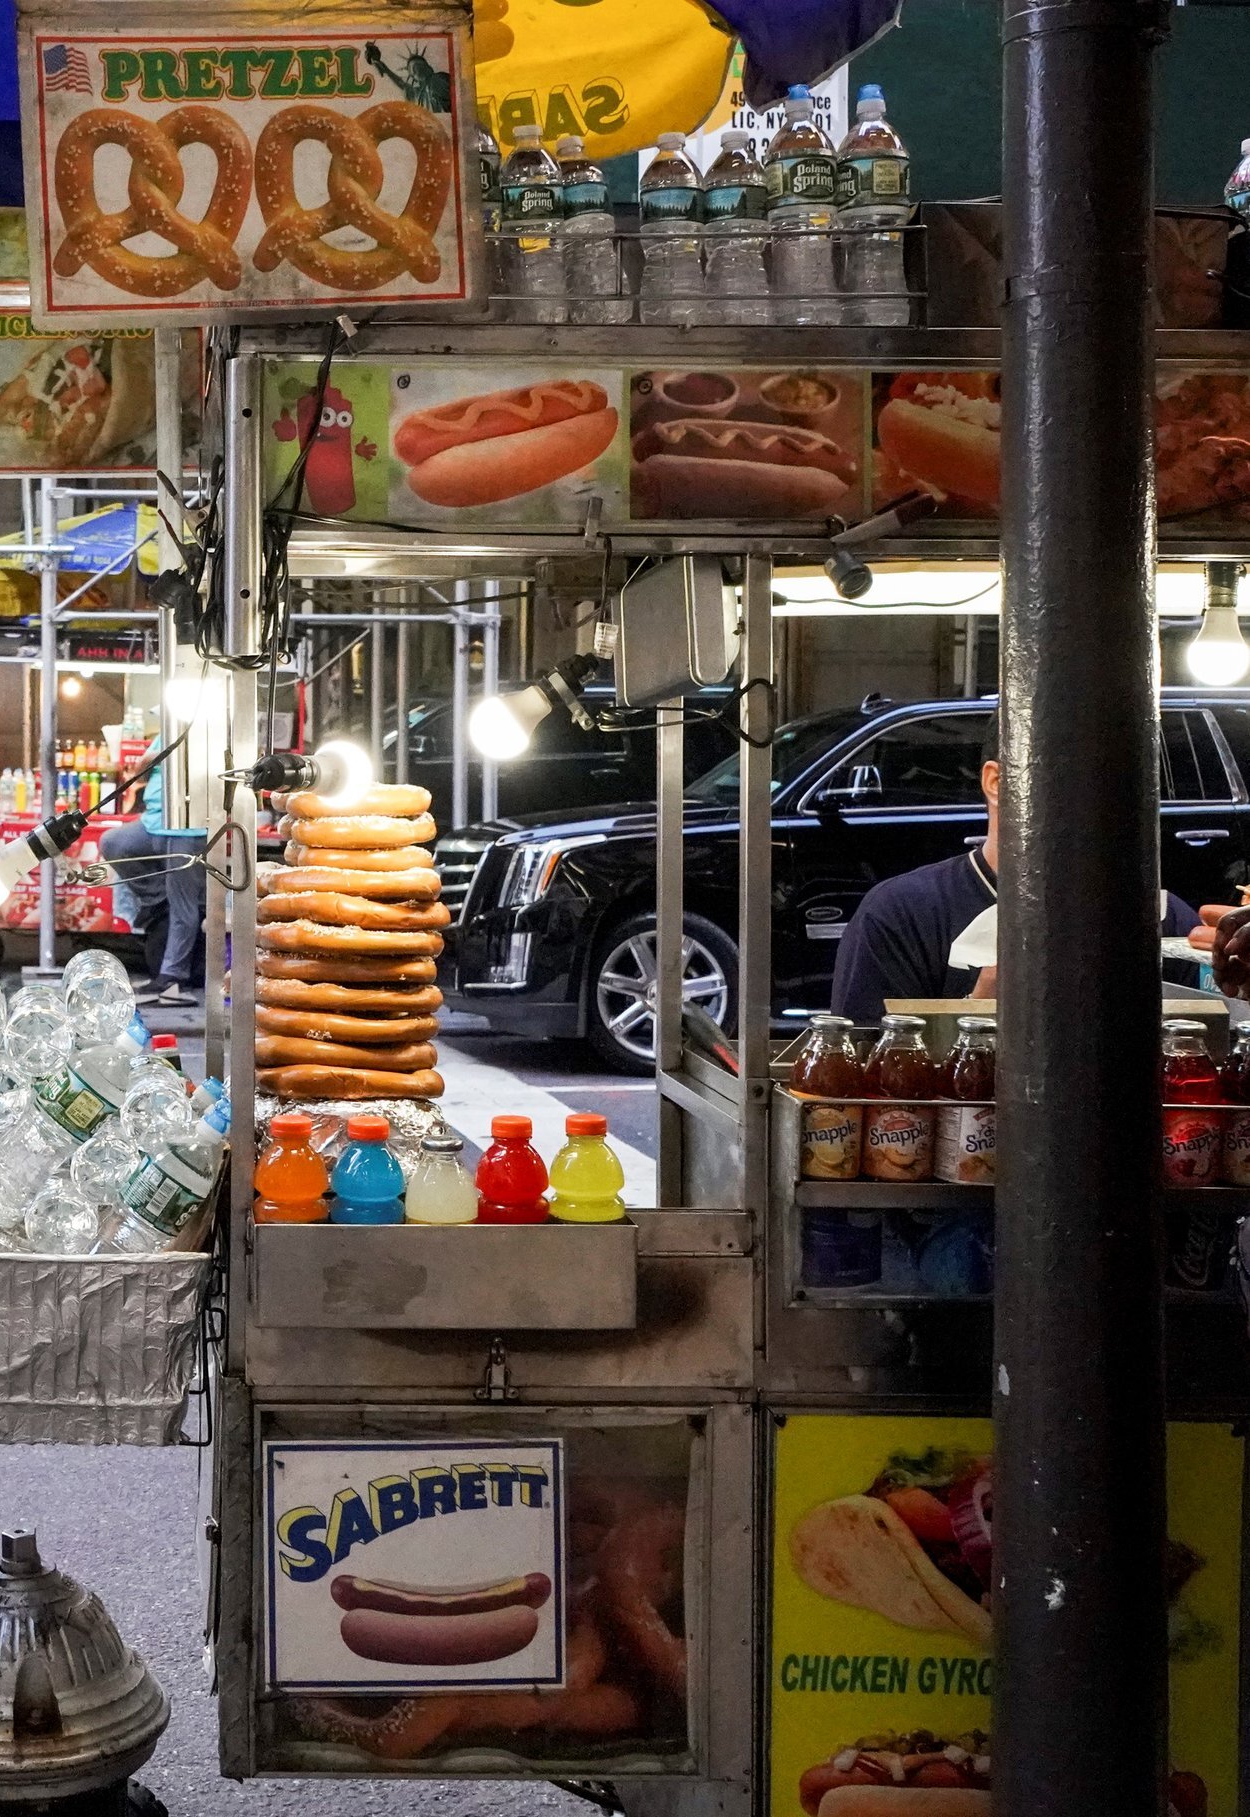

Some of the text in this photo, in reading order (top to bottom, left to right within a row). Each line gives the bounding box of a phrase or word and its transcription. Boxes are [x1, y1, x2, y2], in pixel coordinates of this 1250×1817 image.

[100, 46, 375, 102] PRETZEL
[731, 111, 760, 131] LIC,
[796, 163, 832, 176] Poland
[792, 174, 835, 194] Spring
[524, 189, 551, 201] Poland
[277, 1462, 549, 1583] SABRETT
[781, 1654, 910, 1694] CHICKEN
